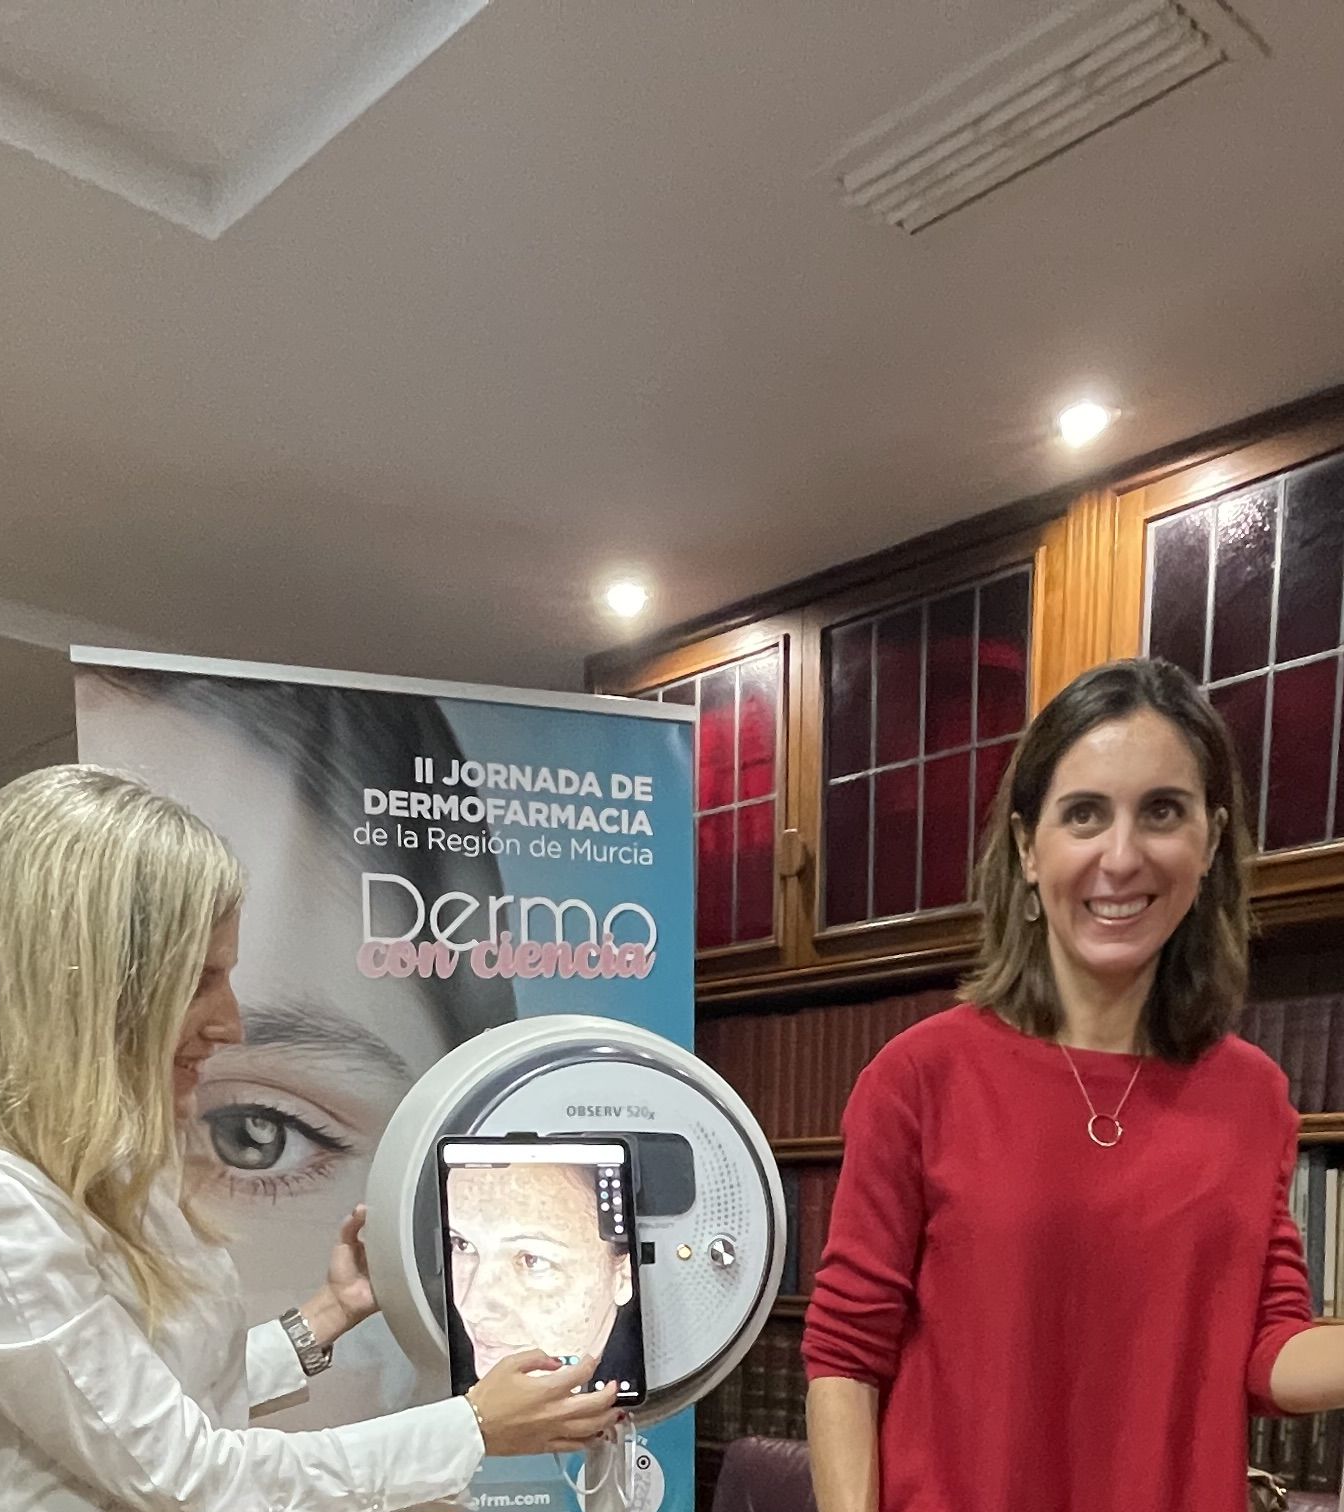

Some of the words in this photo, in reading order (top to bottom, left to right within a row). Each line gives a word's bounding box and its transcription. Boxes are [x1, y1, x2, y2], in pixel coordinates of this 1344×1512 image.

[414, 756, 434, 784] II
[442, 759, 603, 798] JORNADA
[610, 773, 654, 801] DE
[363, 788, 654, 836] DERMOFARMACIA
[353, 821, 388, 846] de
[397, 824, 419, 849] la
[428, 827, 521, 857] Región
[529, 835, 562, 859] de
[570, 838, 653, 865] Murcia
[361, 872, 657, 960] Dermo
[356, 940, 460, 979] con
[470, 930, 656, 980] ciencia
[566, 1105, 622, 1117] OBSERV
